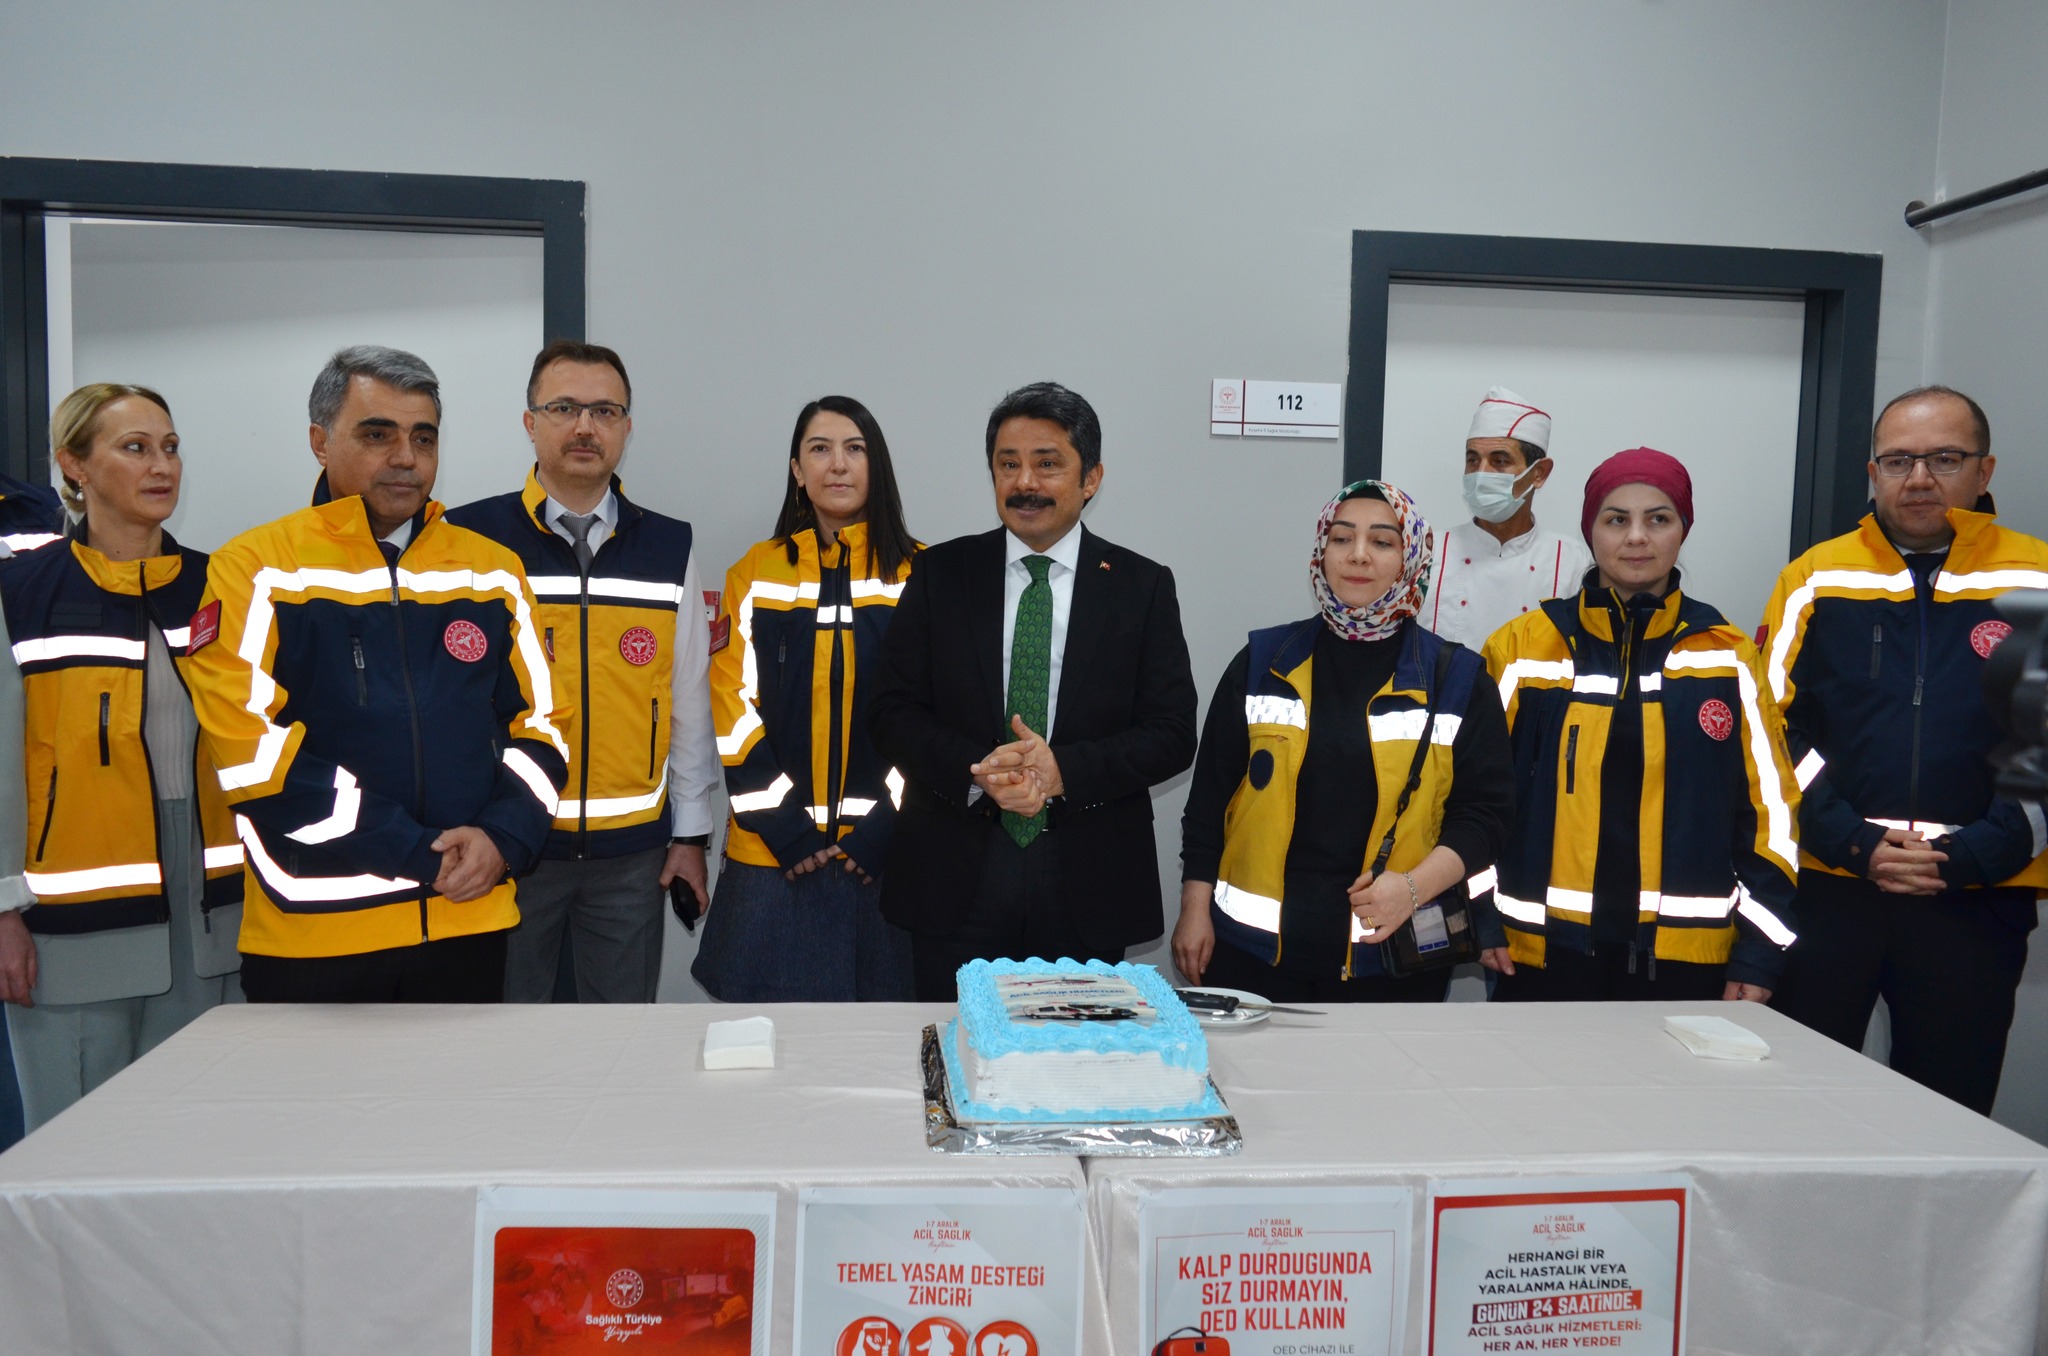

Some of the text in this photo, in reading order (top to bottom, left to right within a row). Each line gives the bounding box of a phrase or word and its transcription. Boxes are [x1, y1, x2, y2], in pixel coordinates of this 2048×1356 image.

[1278, 394, 1303, 411] 112
[937, 1220, 959, 1228] ARALIK
[1508, 1247, 1605, 1263] HERHANGİ BİR
[837, 1263, 898, 1283] TEMEL
[1179, 1254, 1232, 1280] KALP
[1485, 1263, 1627, 1280] ACİL HASTALIK VEYA
[1240, 1279, 1348, 1304] DURMAYIN,
[1478, 1281, 1565, 1295] YARALANMA
[1476, 1292, 1637, 1323] GÜNÜN 24 SAATİNDE,
[585, 1313, 662, 1327] Sağlıklı Türkiye
[1200, 1307, 1345, 1334] OED KULLANIN
[1467, 1318, 1642, 1337] ACİL SAĞLIK HİZMETLERİ:
[1273, 1345, 1296, 1355] OED
[1484, 1336, 1621, 1352] HER AN, HER YERDE!
